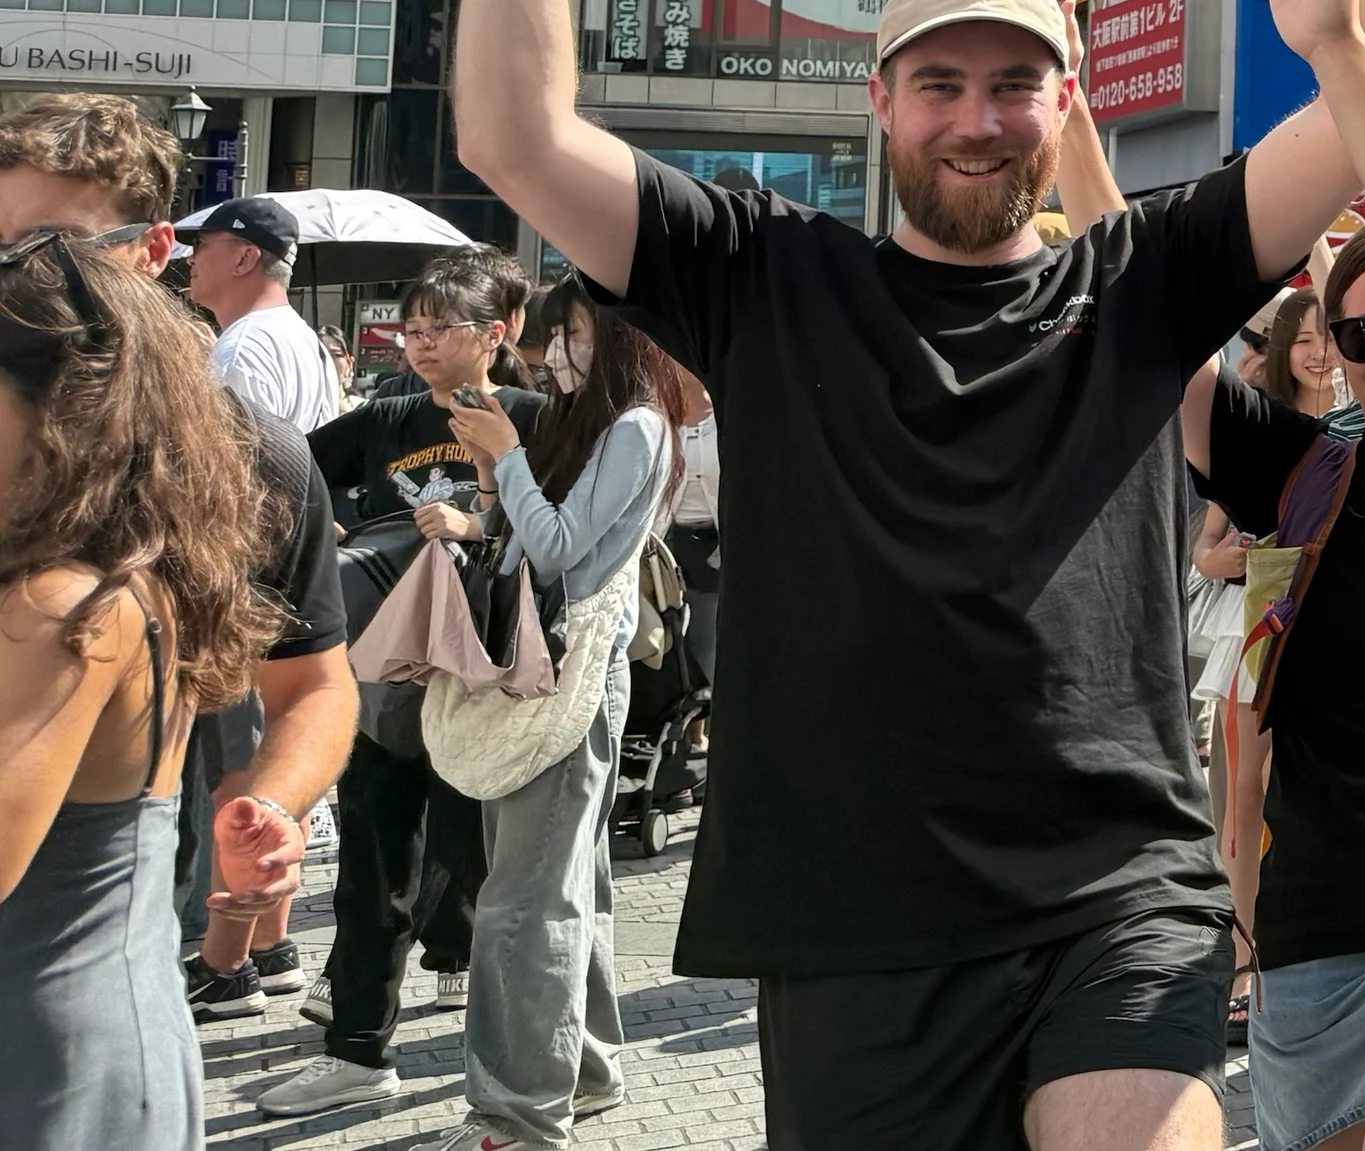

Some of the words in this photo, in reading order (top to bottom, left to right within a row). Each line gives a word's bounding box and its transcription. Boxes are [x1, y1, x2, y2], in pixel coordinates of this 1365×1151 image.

[720, 56, 774, 77] OKO
[372, 307, 395, 320] NY
[386, 444, 444, 480] TROPHY
